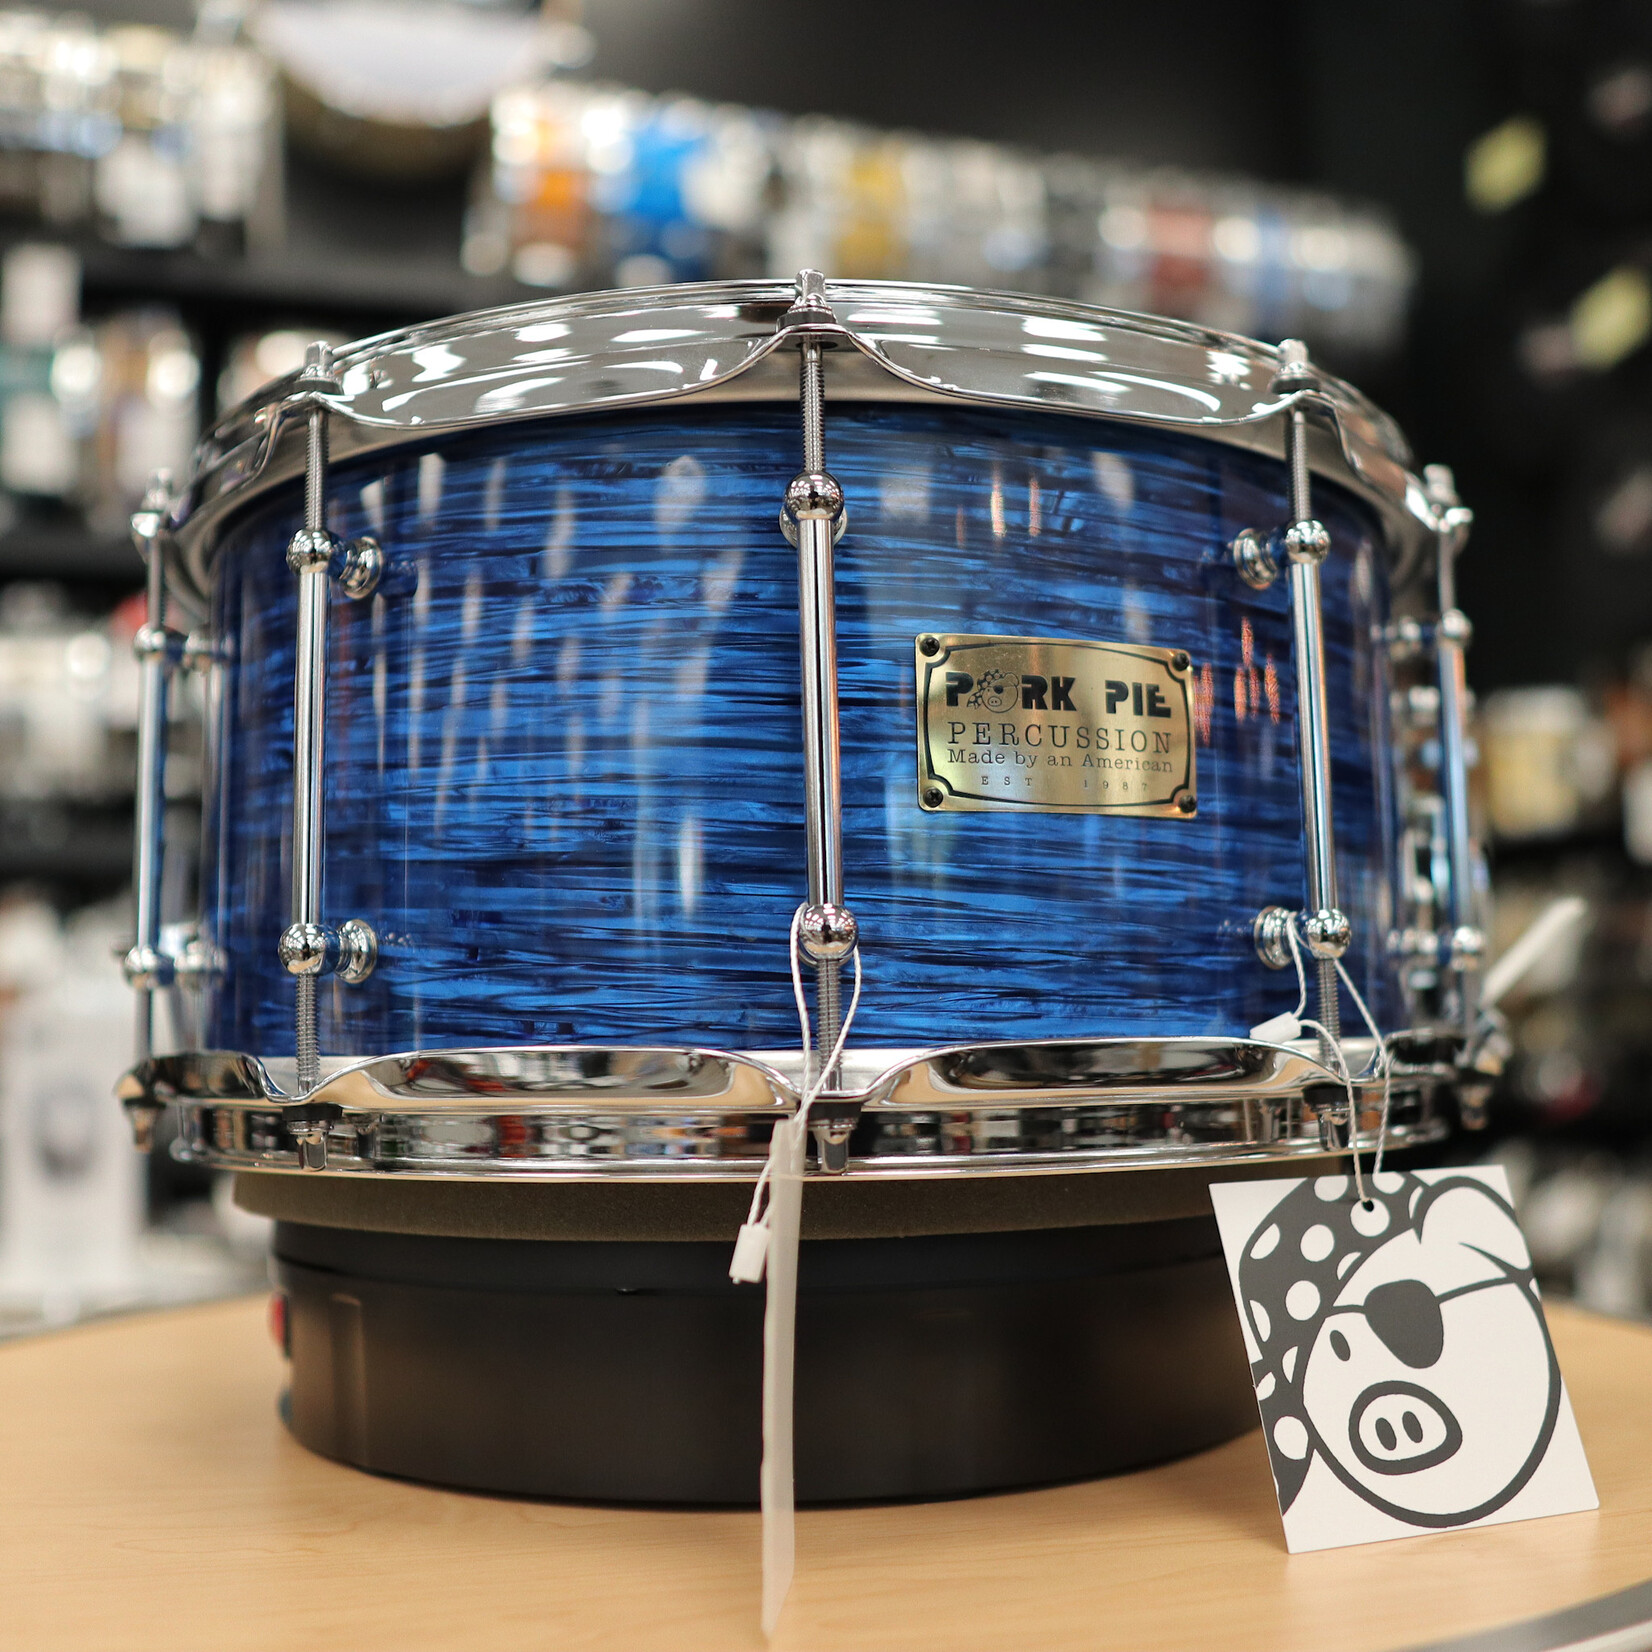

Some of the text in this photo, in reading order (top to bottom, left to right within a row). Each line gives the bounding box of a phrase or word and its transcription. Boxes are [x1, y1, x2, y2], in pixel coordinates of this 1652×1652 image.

[1105, 680, 1172, 718] PIE
[947, 721, 1172, 754] PERCUSSION
[947, 748, 1173, 773] Made by an American
[981, 775, 1149, 791] EST 1987
